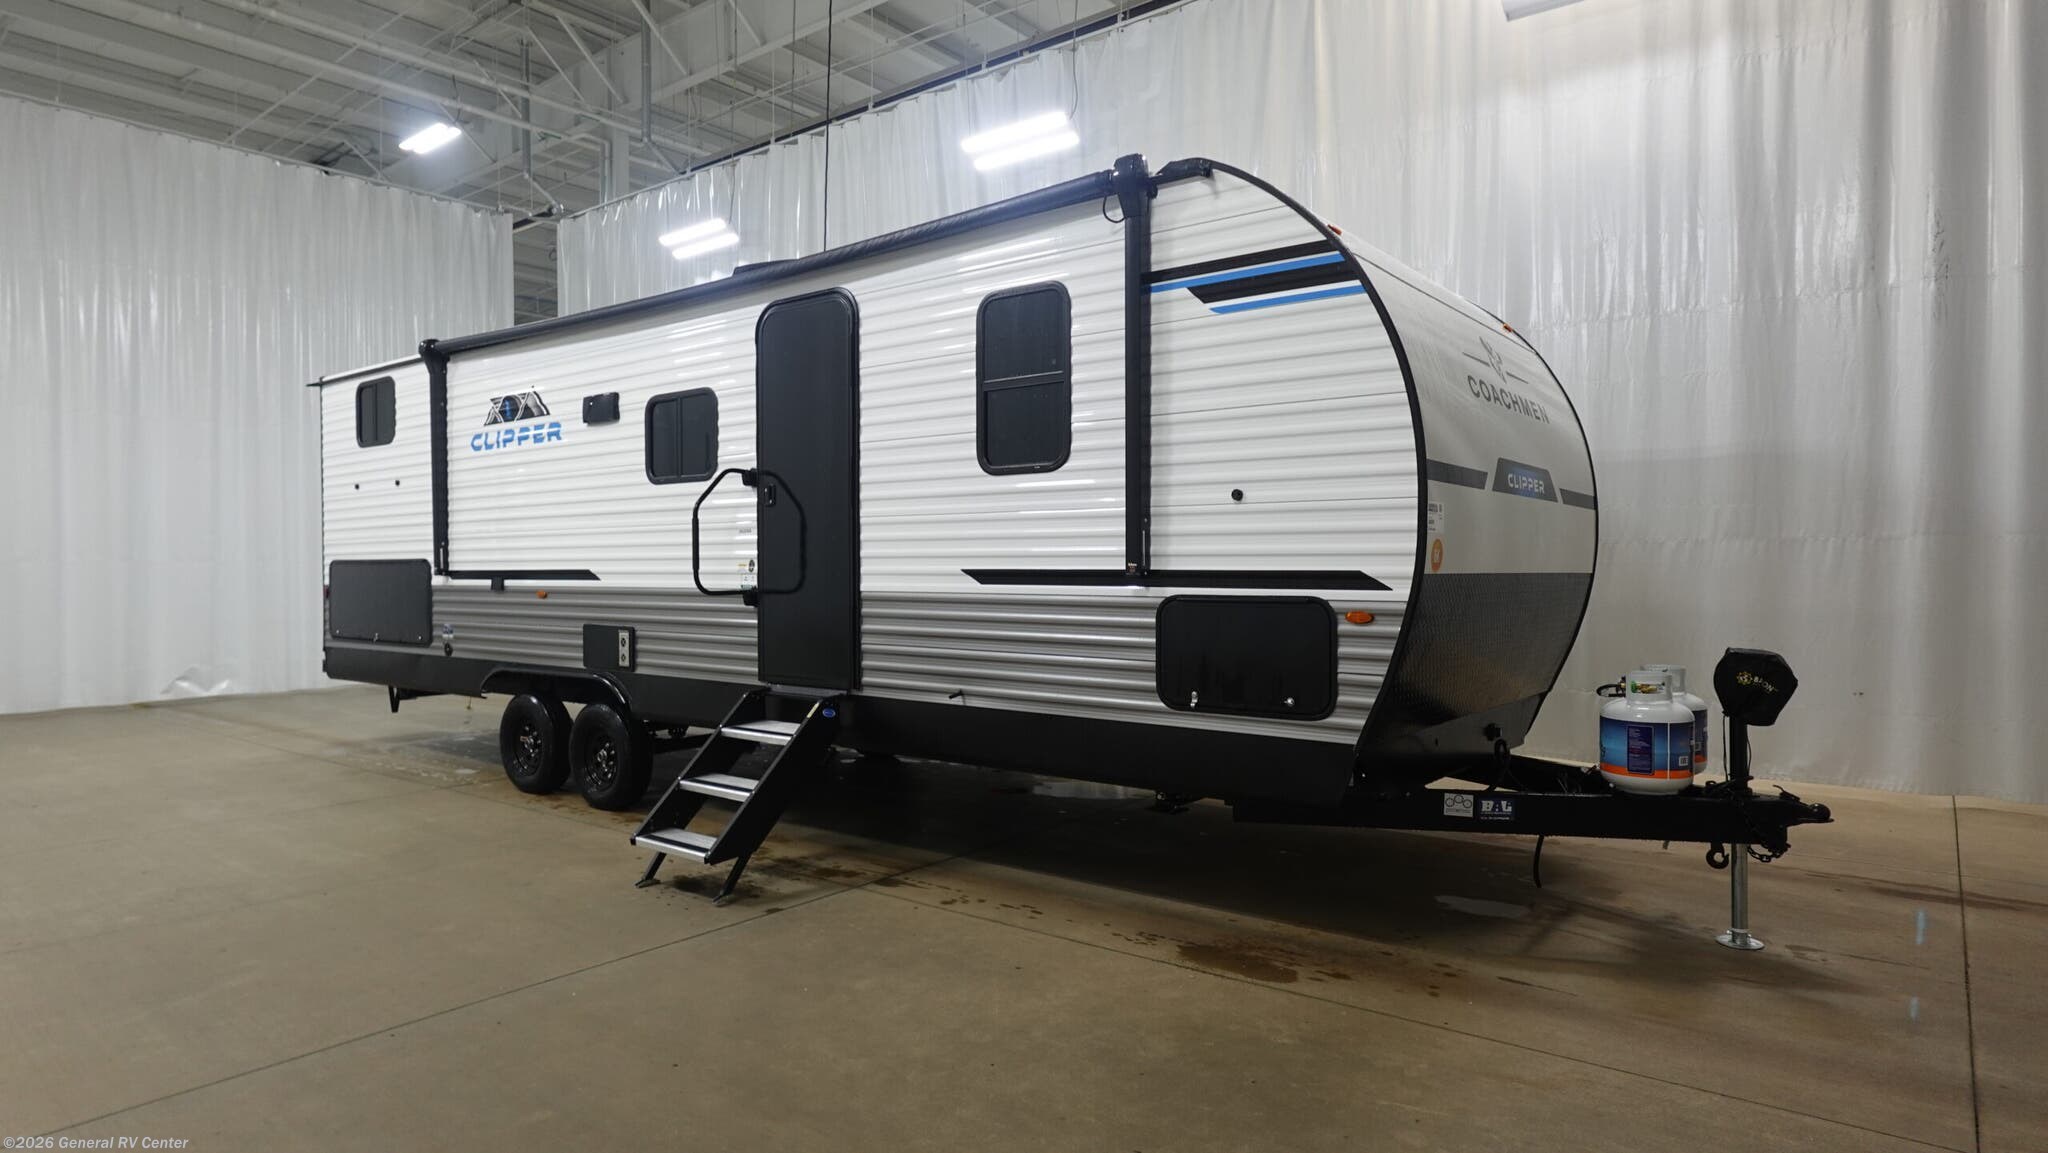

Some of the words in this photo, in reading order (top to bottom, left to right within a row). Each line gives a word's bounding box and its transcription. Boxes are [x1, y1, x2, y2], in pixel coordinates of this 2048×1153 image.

[1467, 374, 1550, 424] COACHMEN
[470, 421, 562, 452] CLIPPER
[1507, 473, 1545, 494] CLIPPER
